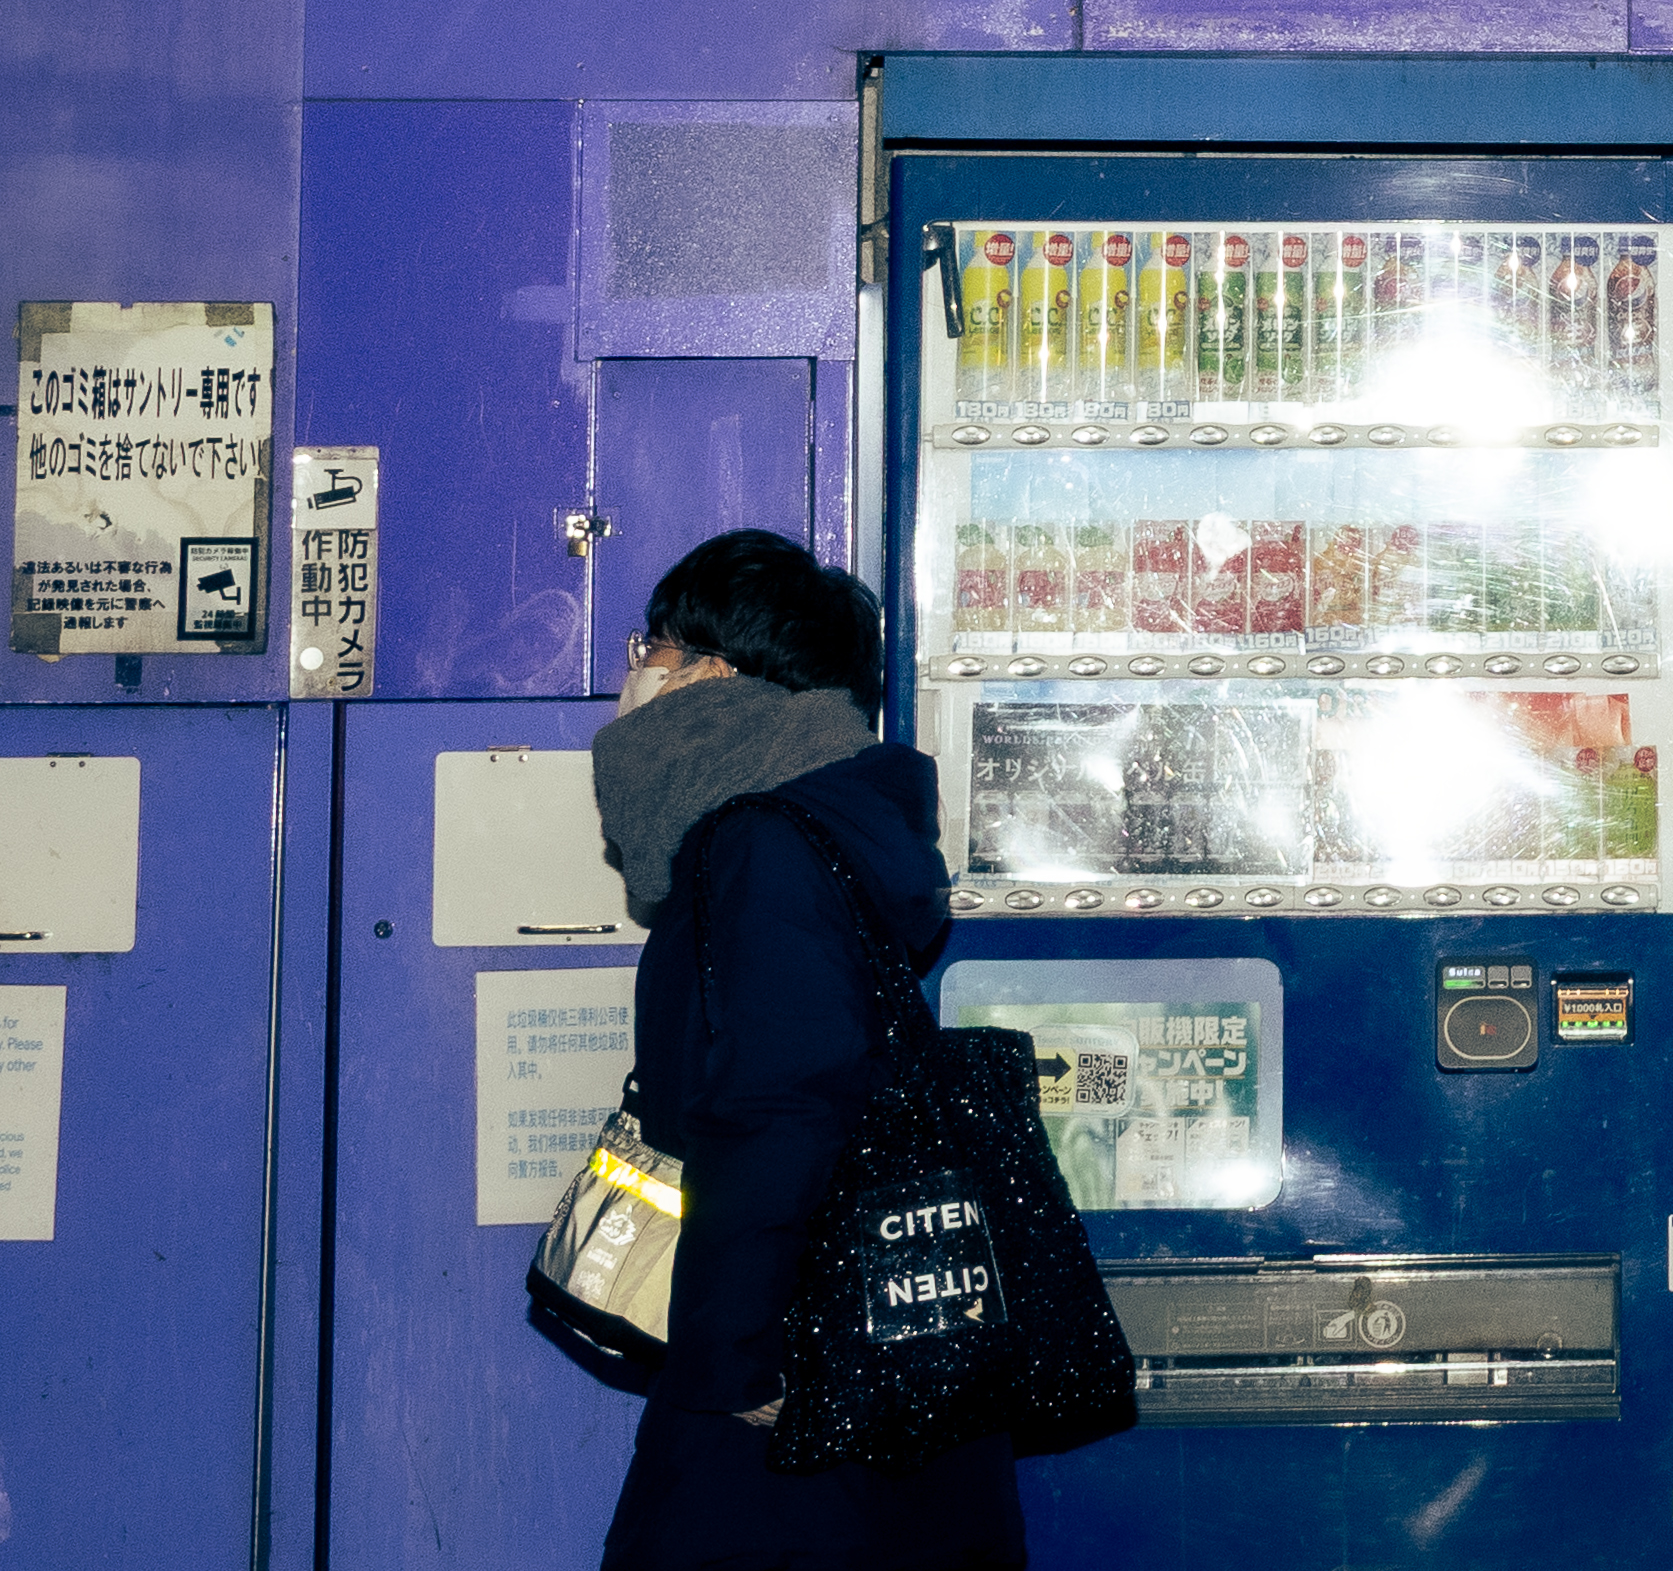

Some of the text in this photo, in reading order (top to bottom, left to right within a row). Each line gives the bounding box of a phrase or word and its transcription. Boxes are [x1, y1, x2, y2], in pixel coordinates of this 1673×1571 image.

[30, 365, 262, 420] このゴミ箱はサントリー専用です
[300, 530, 334, 627] 作動中
[337, 529, 368, 692] 防犯カメラ
[1447, 967, 1482, 977] Suica
[1139, 1048, 1248, 1077] ャンペーン
[880, 1200, 981, 1241] CITEN
